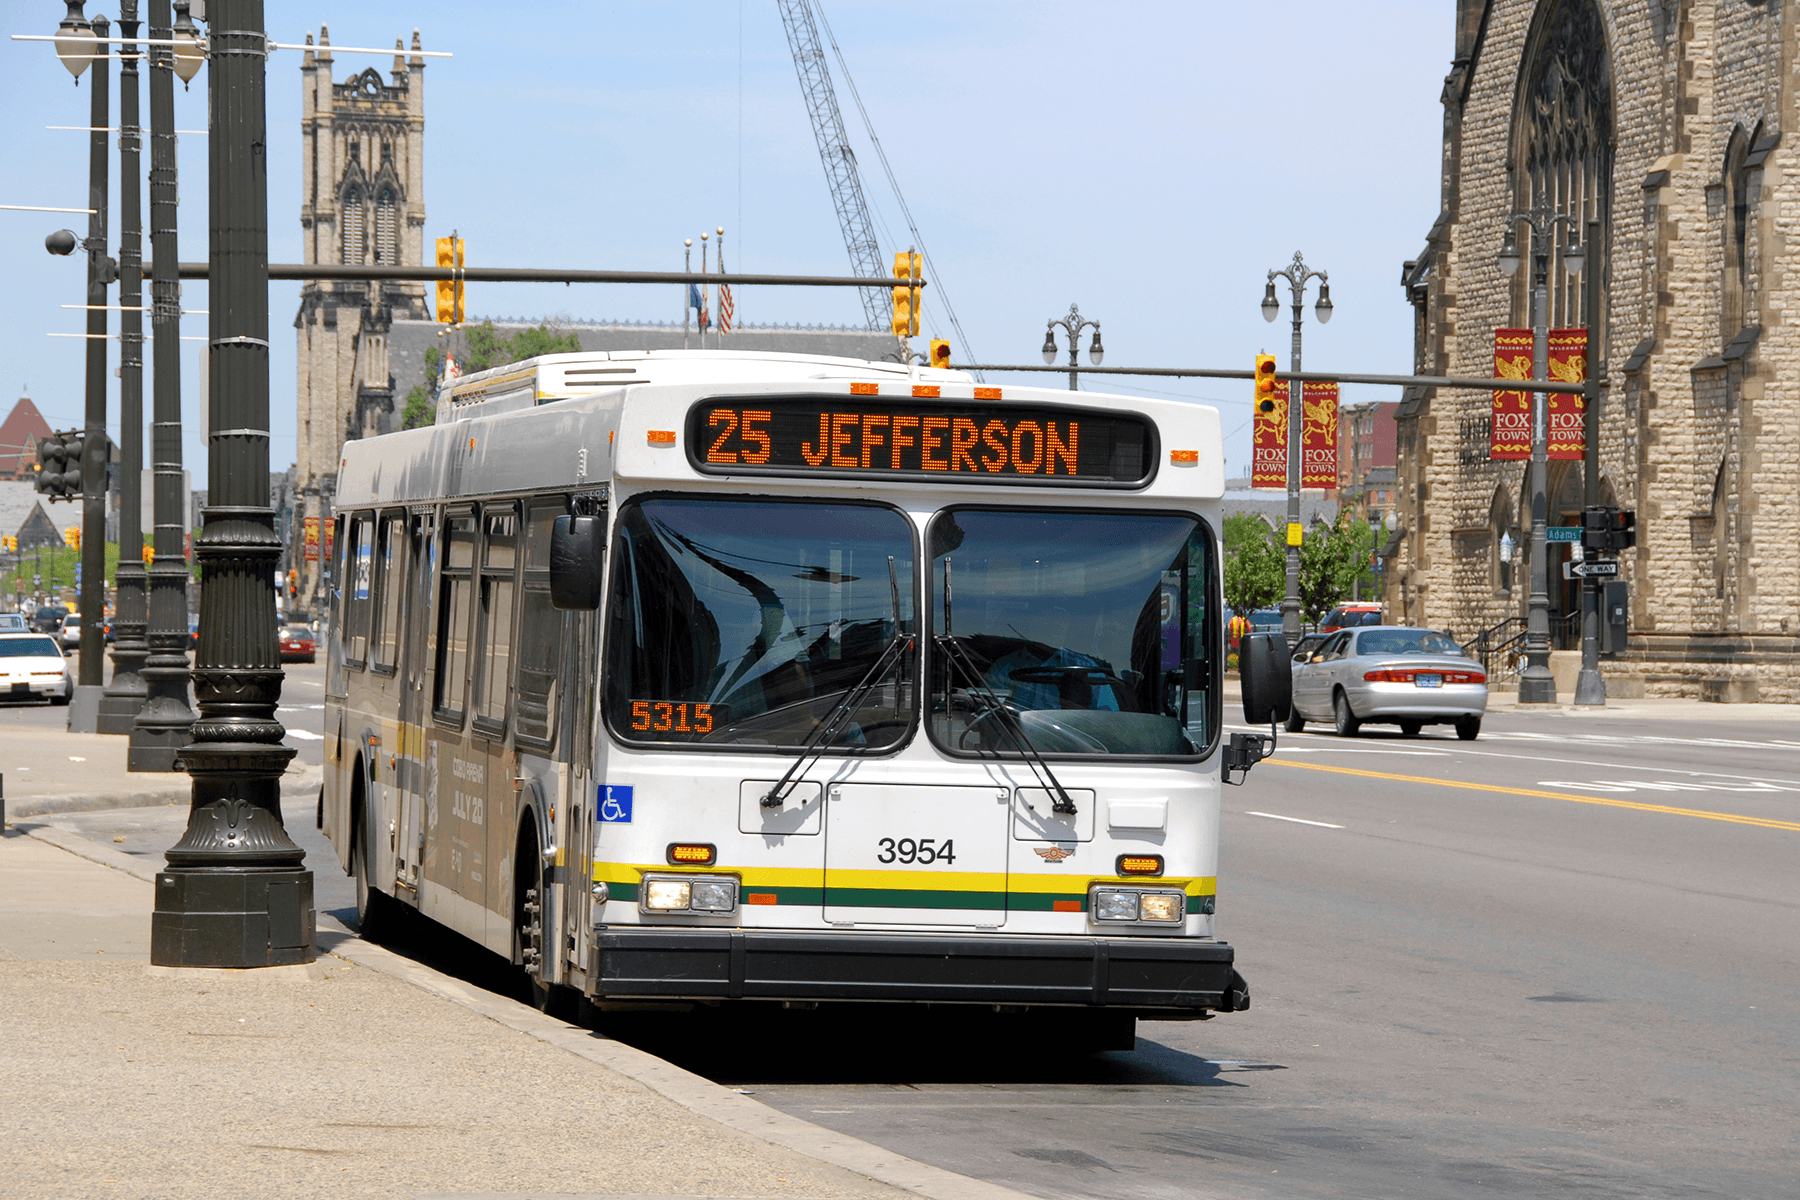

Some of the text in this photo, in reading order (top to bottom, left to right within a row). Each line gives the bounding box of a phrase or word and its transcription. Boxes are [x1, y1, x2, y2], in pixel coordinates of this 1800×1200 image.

[1495, 413, 1530, 427] FOX
[1551, 413, 1586, 427] FOX
[708, 409, 1078, 475] 25 JEFFERSON
[1494, 431, 1530, 440] TOWN
[1550, 431, 1586, 440] TOWN
[1256, 448, 1286, 461] FOX
[1305, 449, 1336, 462] FOX
[1255, 463, 1286, 472] TOWN
[1305, 464, 1336, 473] TOWN
[1549, 530, 1577, 539] Adams
[1579, 565, 1594, 573] ONE
[632, 701, 713, 733] 5315
[472, 796, 483, 825] 20
[877, 837, 956, 865] 3954
